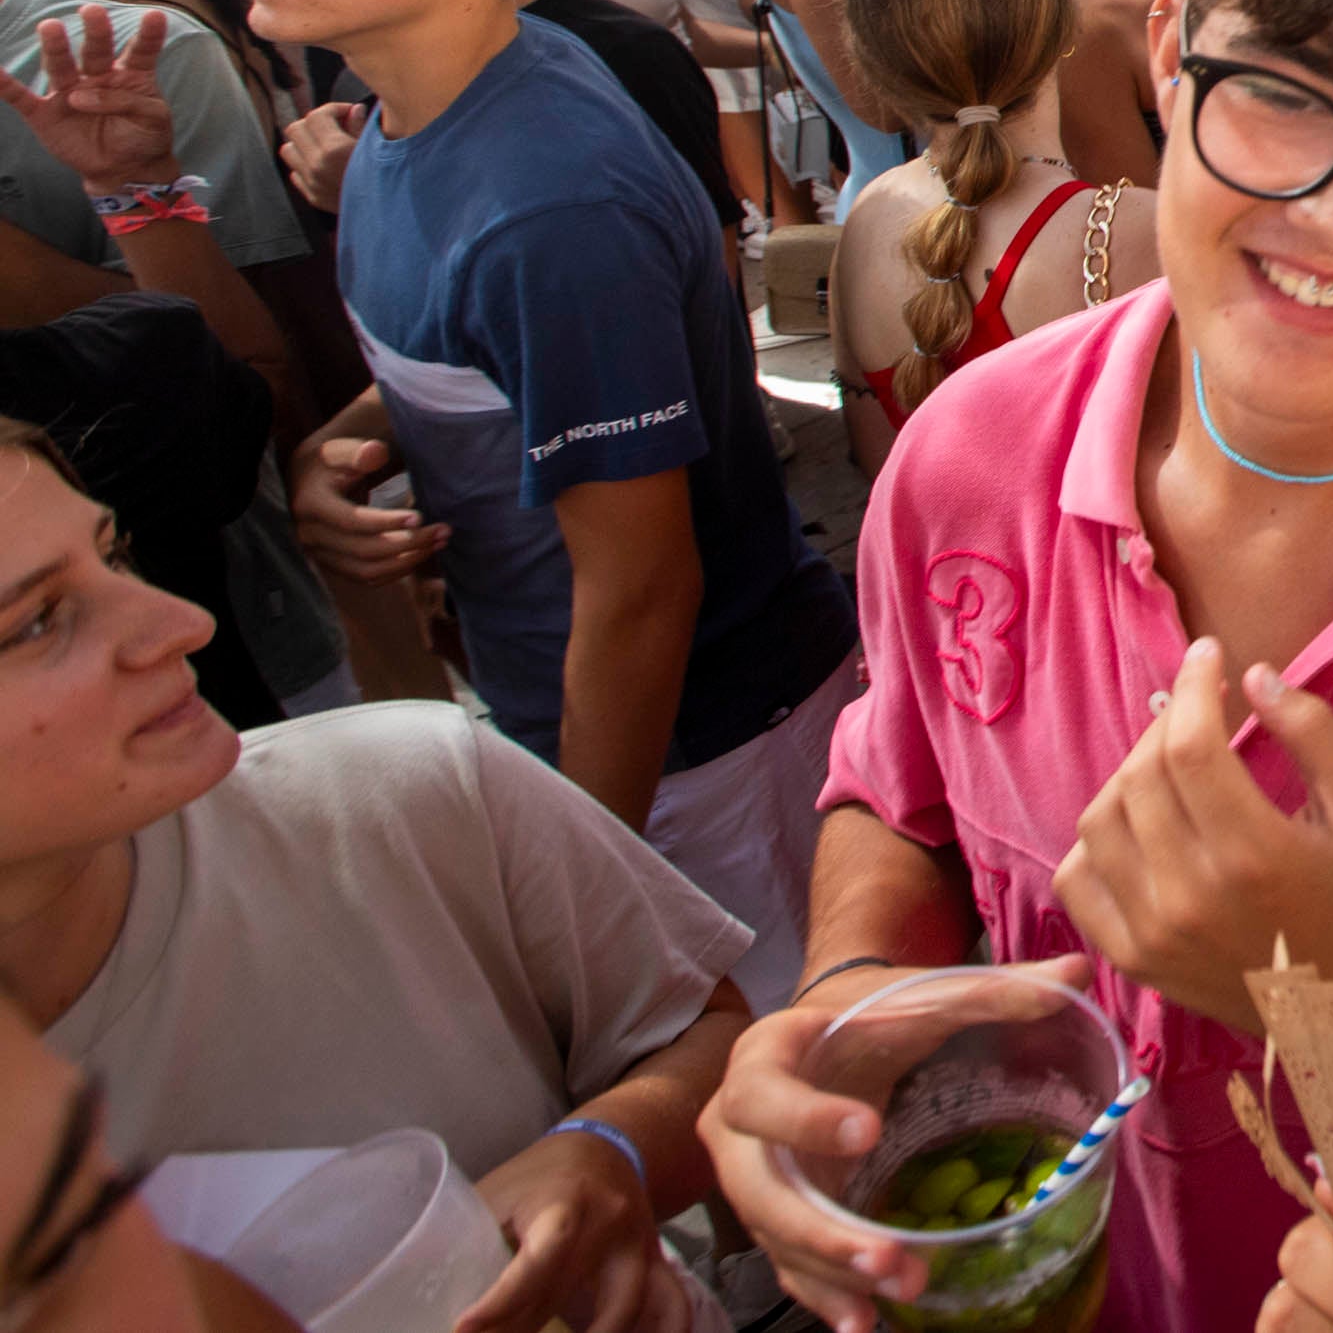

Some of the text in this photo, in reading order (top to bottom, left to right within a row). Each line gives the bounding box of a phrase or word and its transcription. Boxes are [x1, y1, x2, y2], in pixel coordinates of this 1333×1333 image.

[528, 399, 689, 462] THE NORTH FACE
